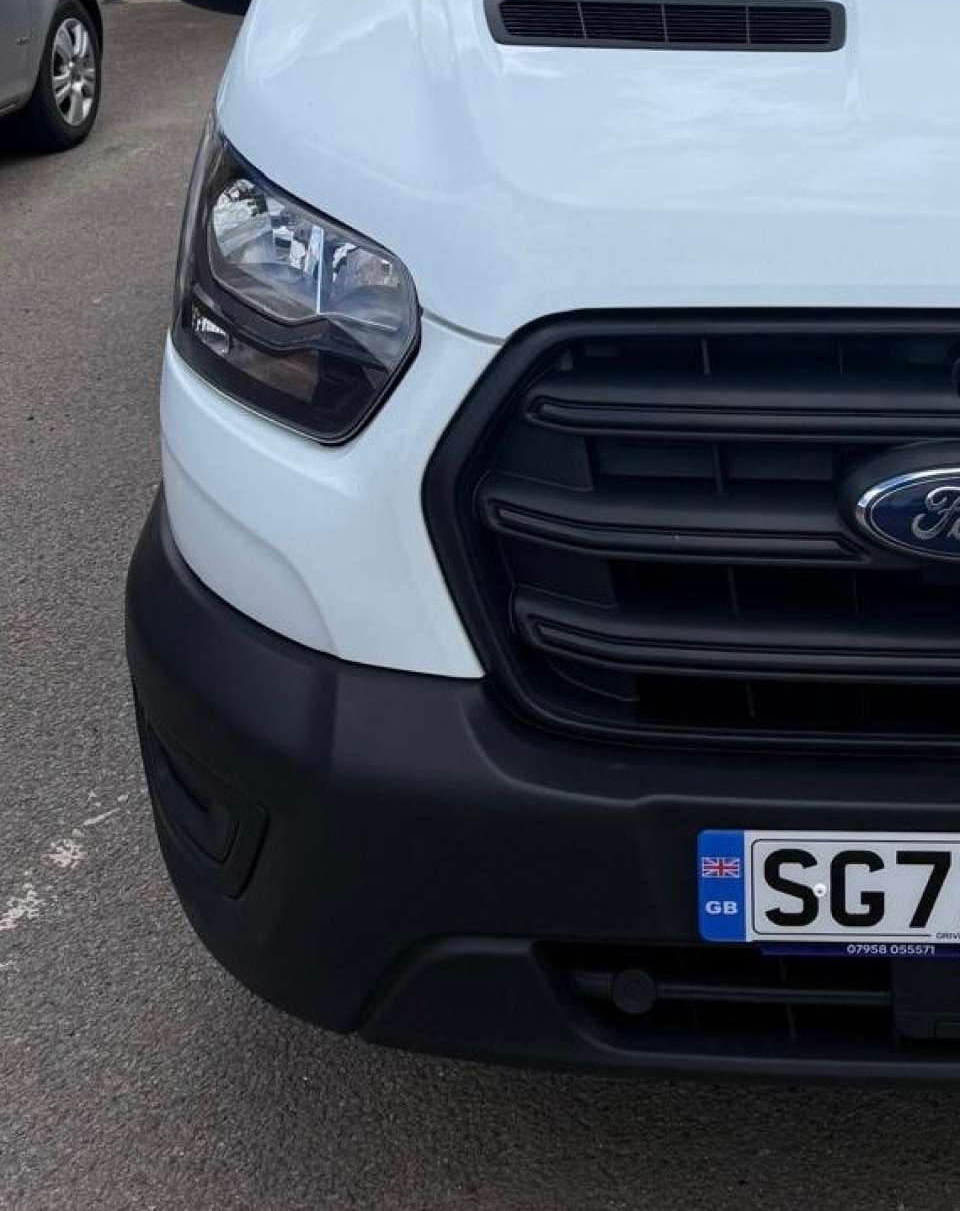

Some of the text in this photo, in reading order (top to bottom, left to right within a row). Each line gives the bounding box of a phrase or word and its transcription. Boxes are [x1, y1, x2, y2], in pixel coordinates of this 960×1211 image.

[705, 900, 739, 915] GB
[846, 944, 887, 955] 07958
[890, 944, 935, 955] 055571
